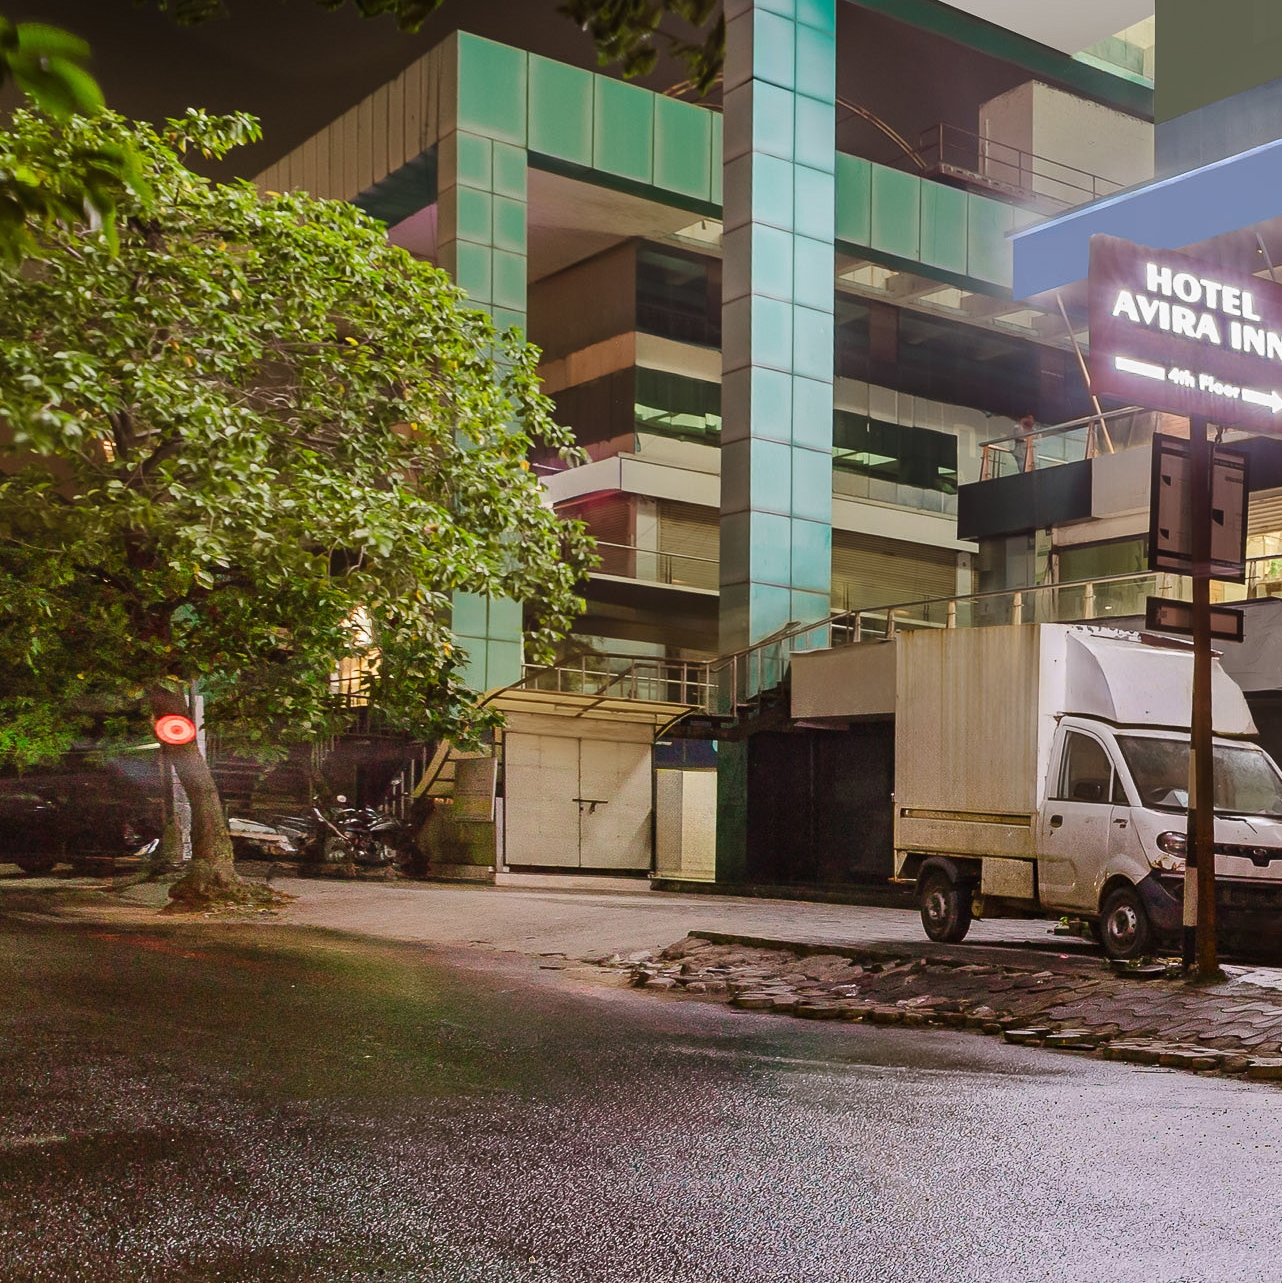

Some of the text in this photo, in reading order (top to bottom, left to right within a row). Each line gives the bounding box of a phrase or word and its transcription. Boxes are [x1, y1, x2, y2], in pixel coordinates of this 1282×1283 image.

[1112, 290, 1221, 345] AVIRA
[1146, 262, 1261, 321] HOTEL
[1168, 366, 1241, 399] 4th Floor
